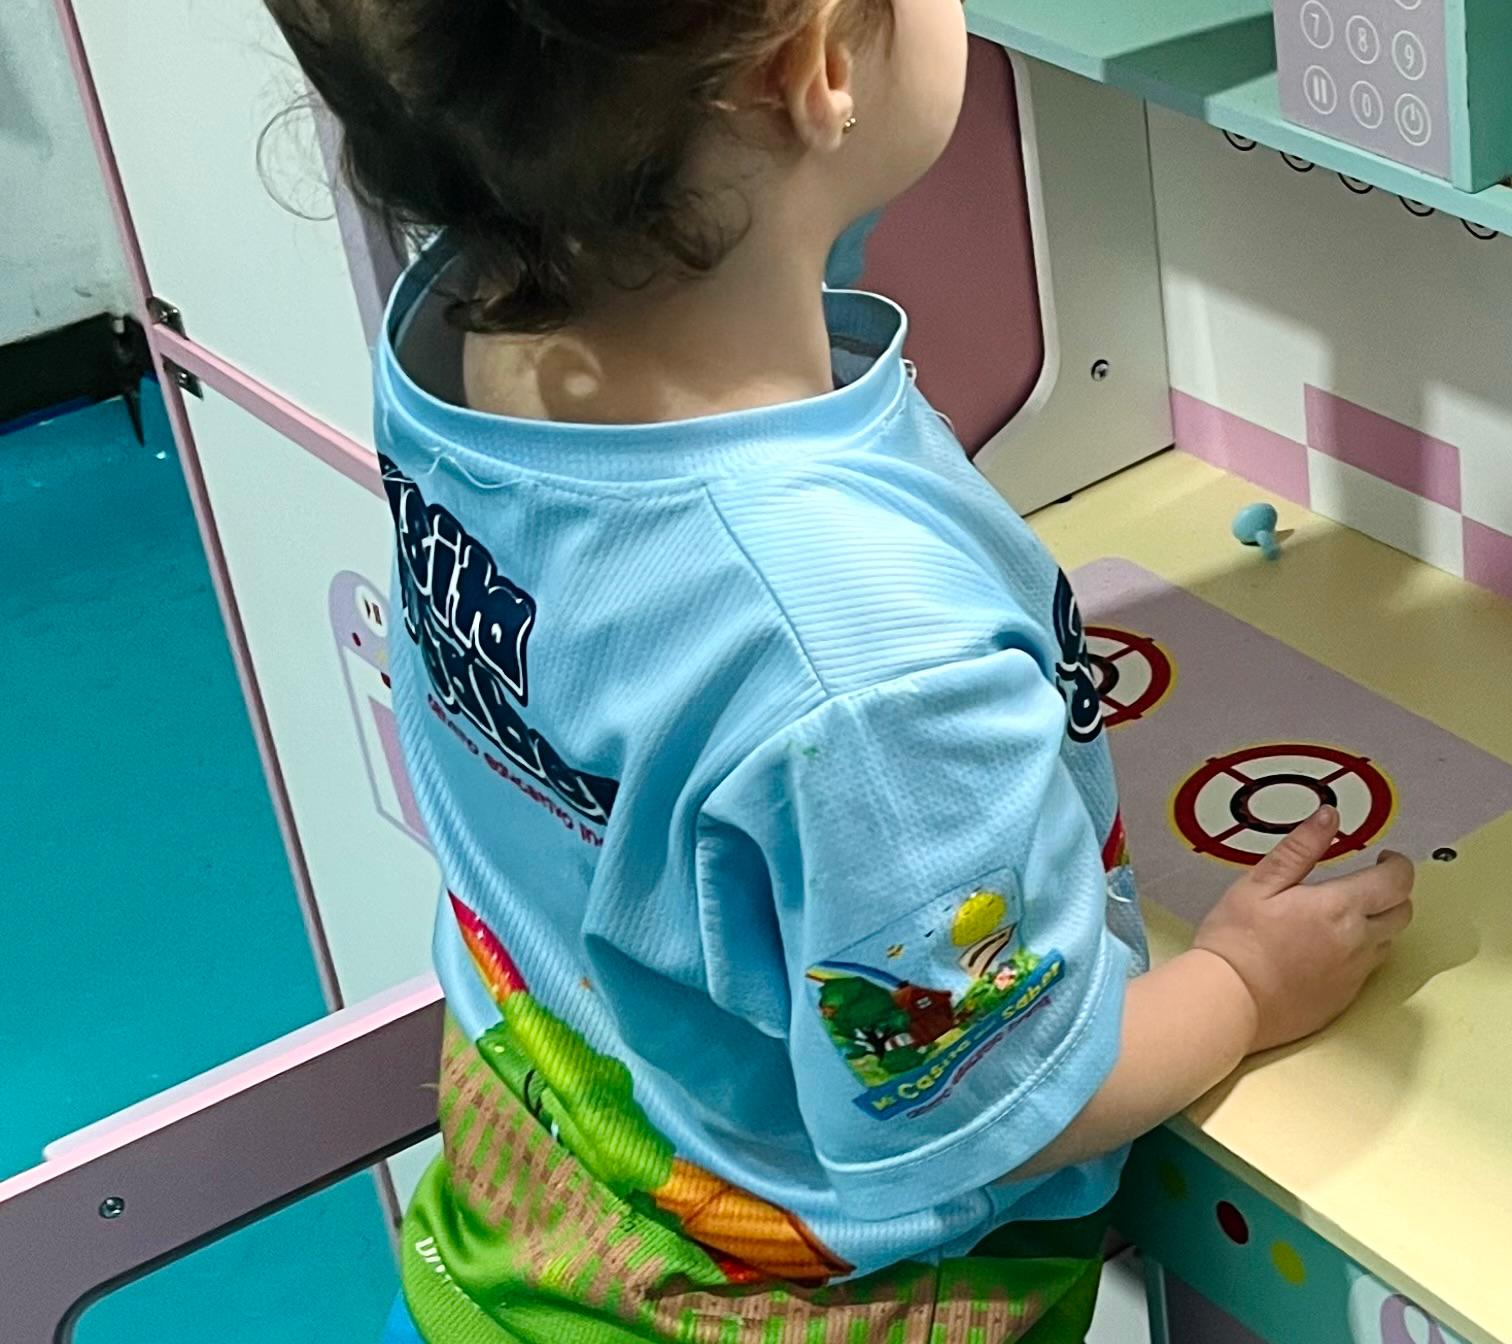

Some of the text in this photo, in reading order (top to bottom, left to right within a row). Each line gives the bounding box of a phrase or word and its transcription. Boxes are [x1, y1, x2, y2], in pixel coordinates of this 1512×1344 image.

[1310, 12, 1416, 71] 7 8 9
[1362, 92, 1373, 119] 0
